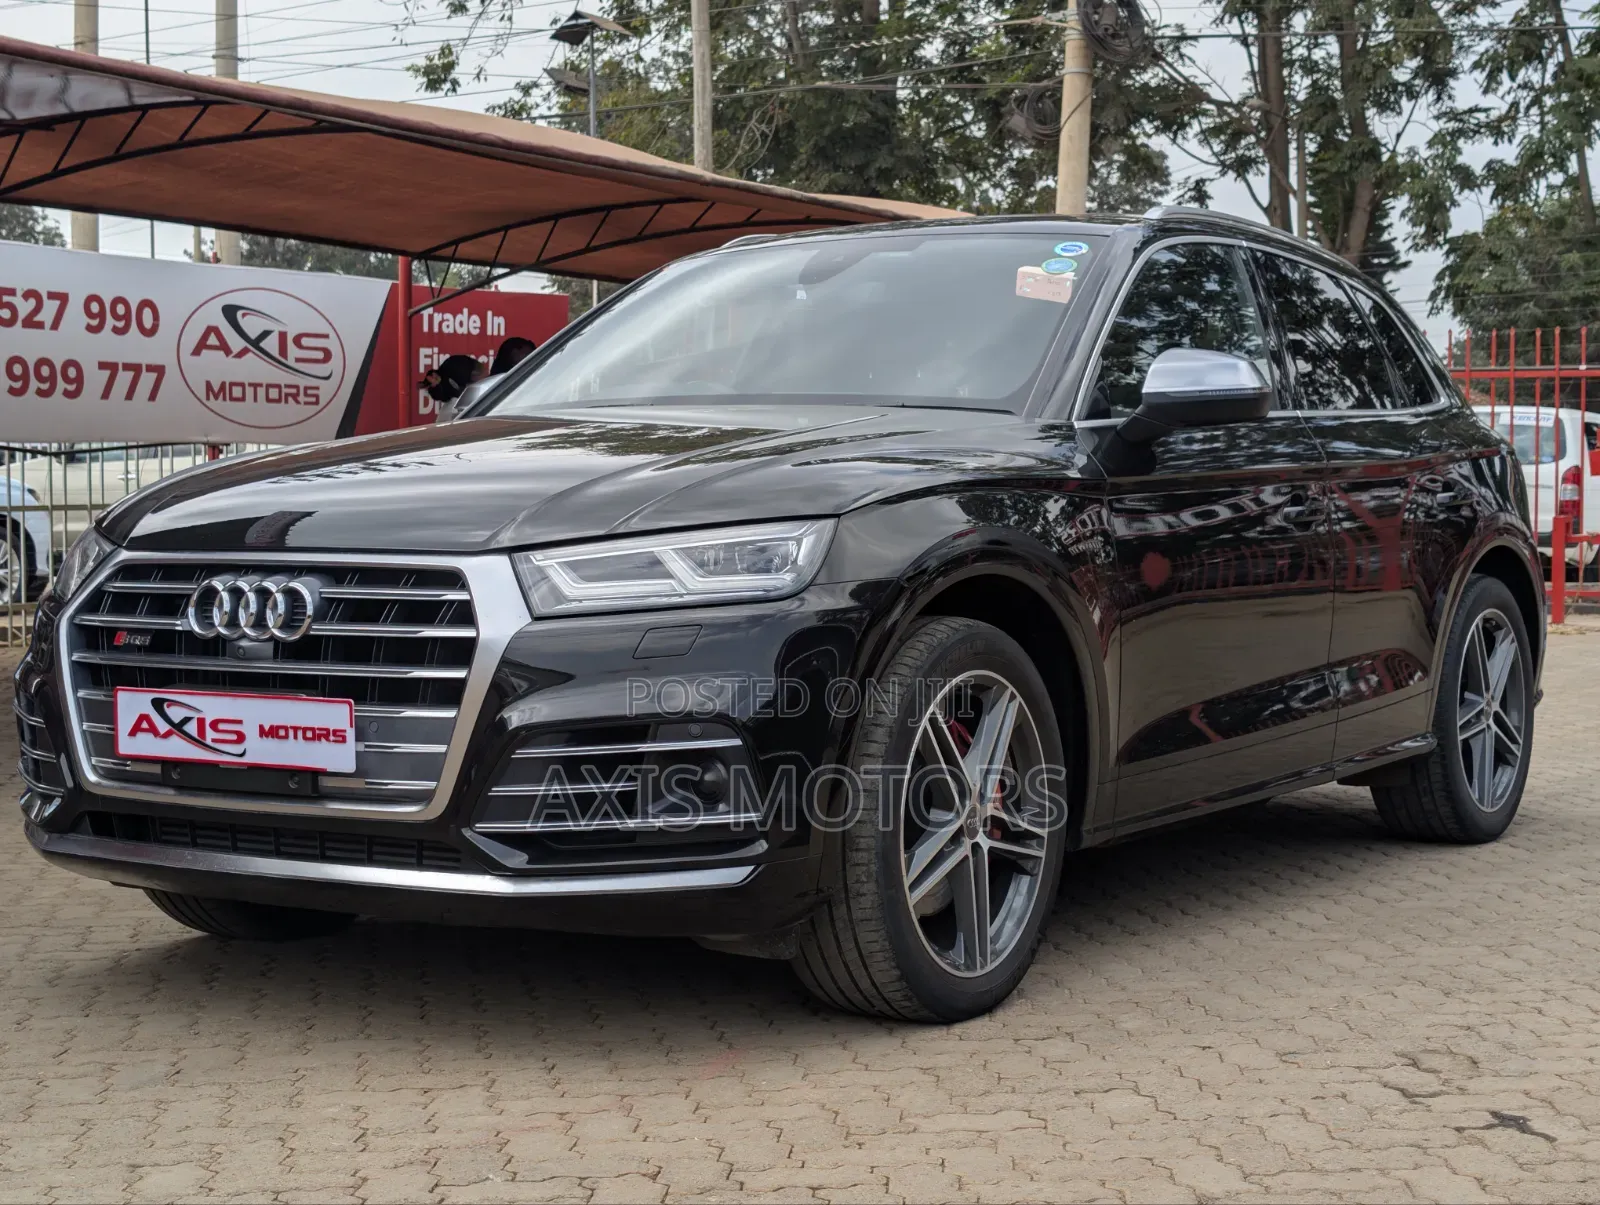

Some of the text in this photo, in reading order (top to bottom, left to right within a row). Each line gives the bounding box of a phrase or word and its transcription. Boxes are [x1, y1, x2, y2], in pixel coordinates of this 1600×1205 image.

[0, 286, 161, 338] 527 990
[420, 307, 506, 336] Trade In
[190, 309, 333, 375] AXIS
[5, 355, 167, 402] 999 777
[205, 380, 321, 406] MOTORS
[127, 703, 347, 752] AXIS MOTORS
